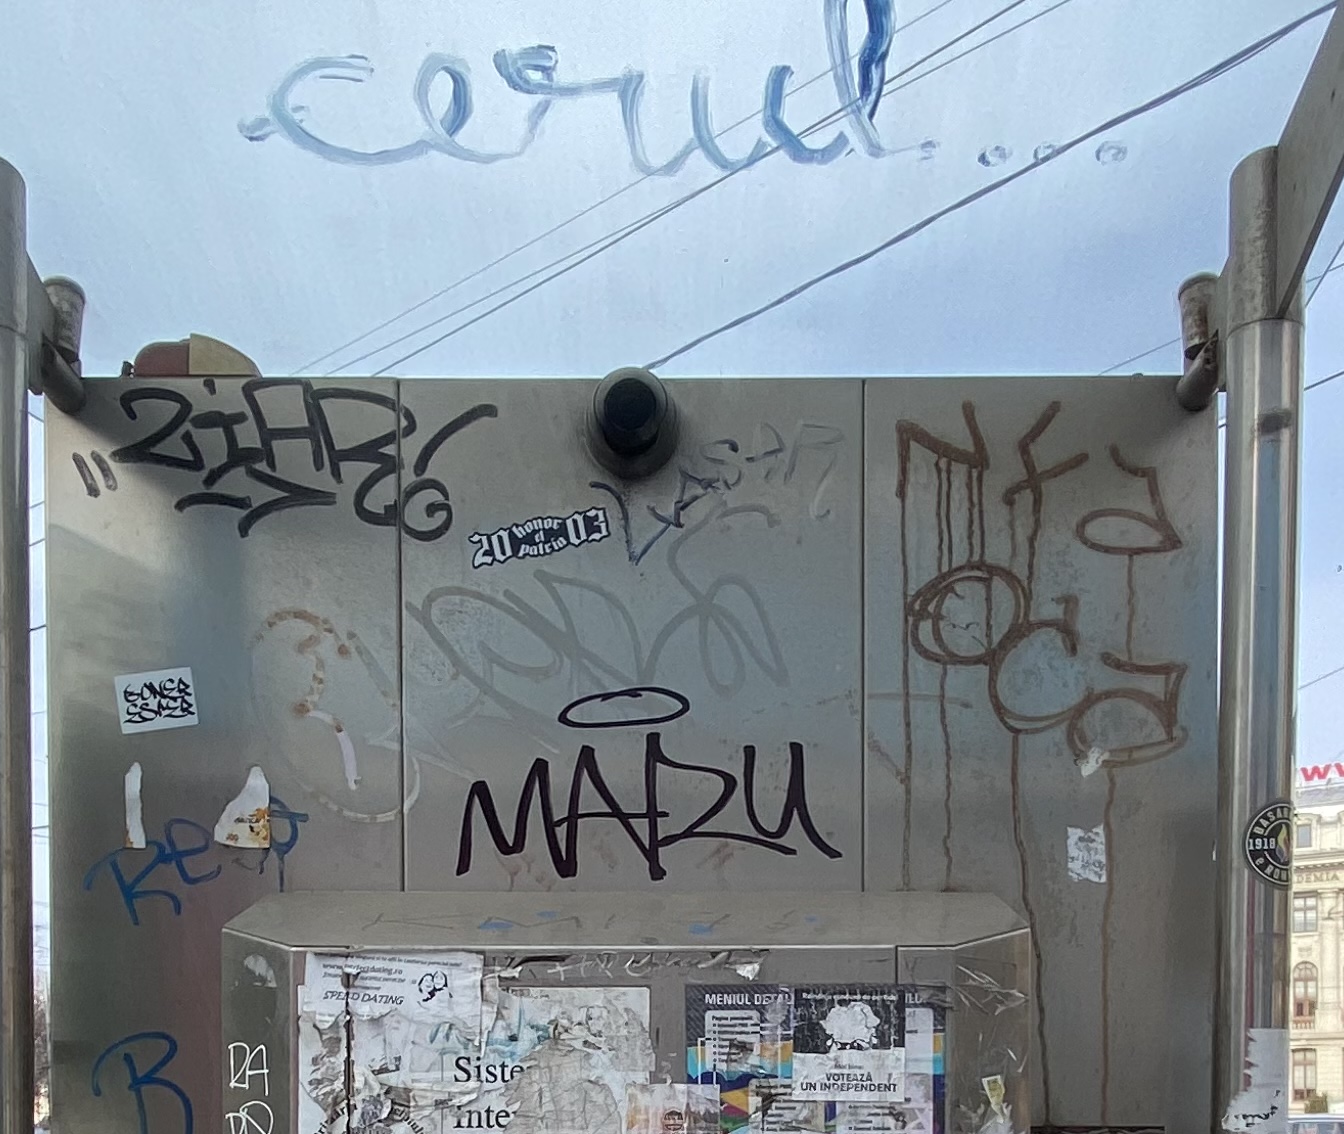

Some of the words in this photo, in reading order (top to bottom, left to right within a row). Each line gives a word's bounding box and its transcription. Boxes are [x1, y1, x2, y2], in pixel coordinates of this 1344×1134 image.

[468, 529, 513, 569] 20
[565, 507, 611, 547] 03
[1248, 838, 1276, 850] 1918
[1297, 870, 1340, 884] DEMIA
[361, 992, 405, 1006] DATING
[704, 994, 752, 1005] MENIUL
[825, 1072, 873, 1083] VOTEAZĂ
[800, 1083, 817, 1092] UN
[819, 1083, 898, 1093] INDEPENDENT
[453, 1104, 518, 1130] Inte
